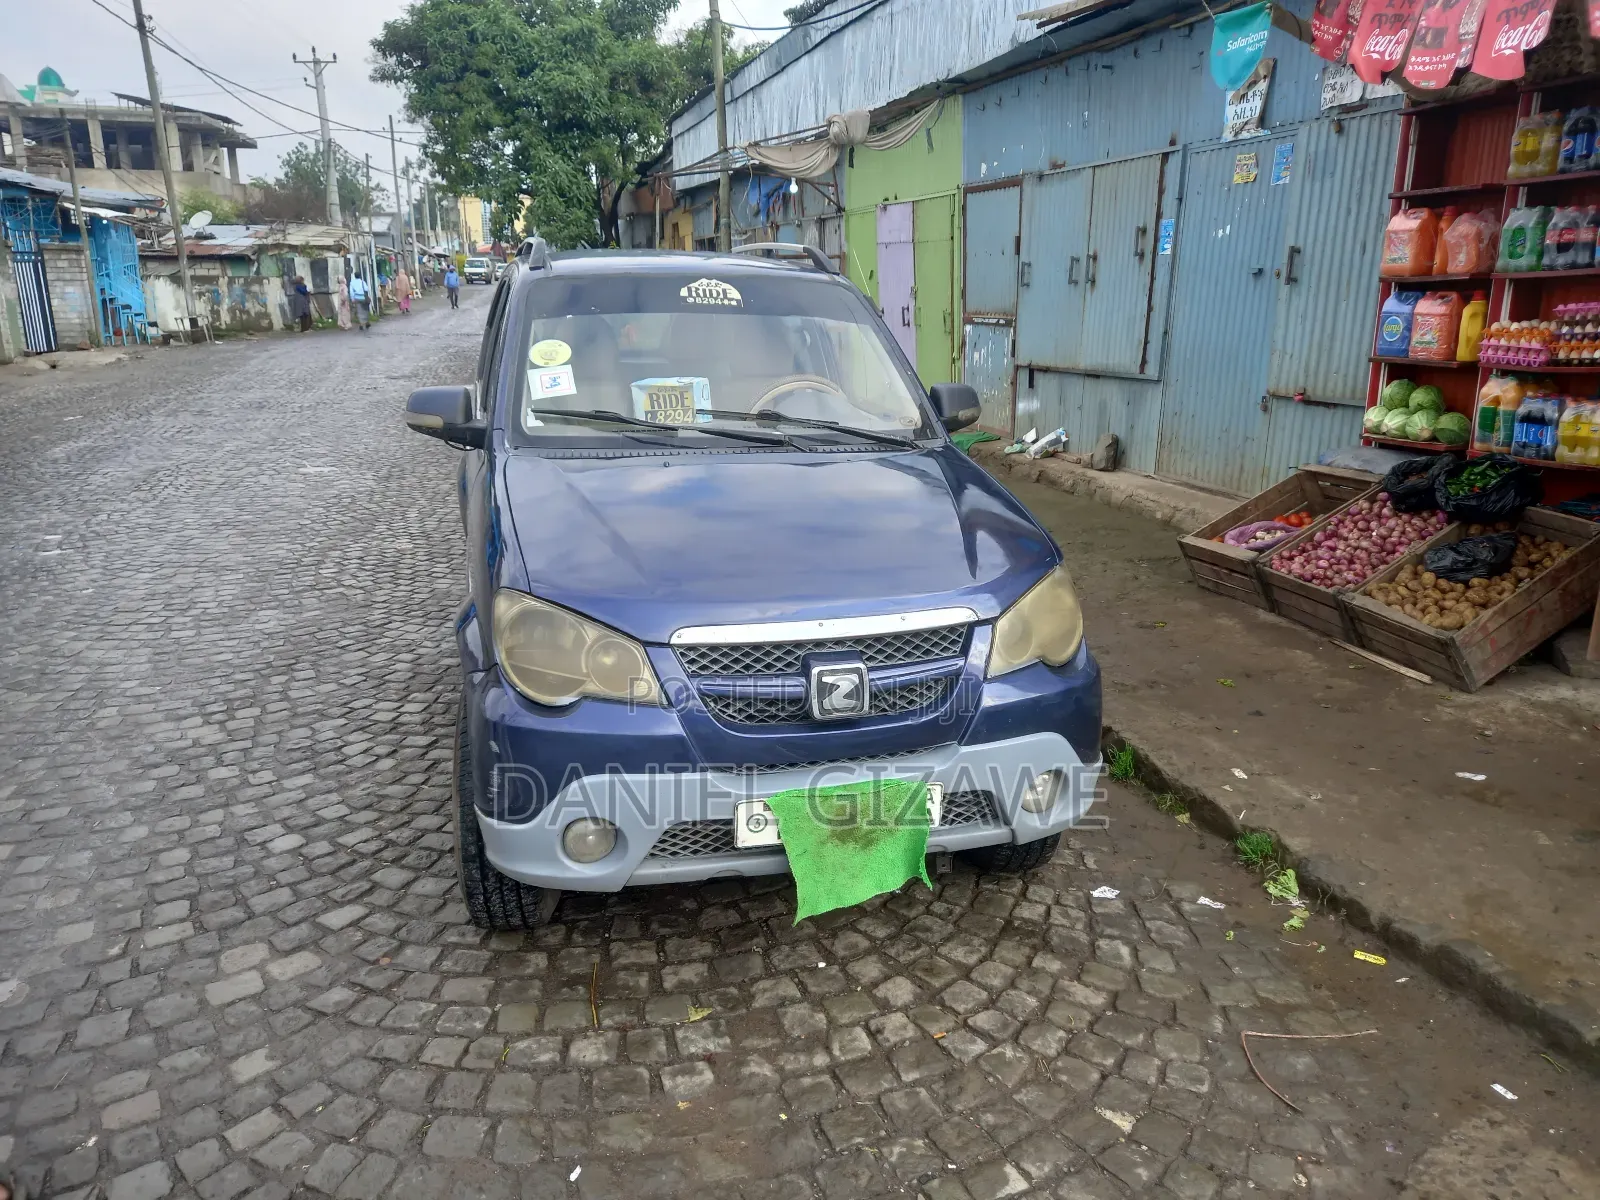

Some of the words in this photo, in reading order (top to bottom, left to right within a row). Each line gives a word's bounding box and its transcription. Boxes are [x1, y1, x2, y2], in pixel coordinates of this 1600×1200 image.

[1227, 30, 1268, 51] Safaricom
[687, 286, 733, 299] RIDE
[695, 297, 722, 305] 8294
[648, 390, 691, 410] RIDE
[656, 408, 693, 424] 8294
